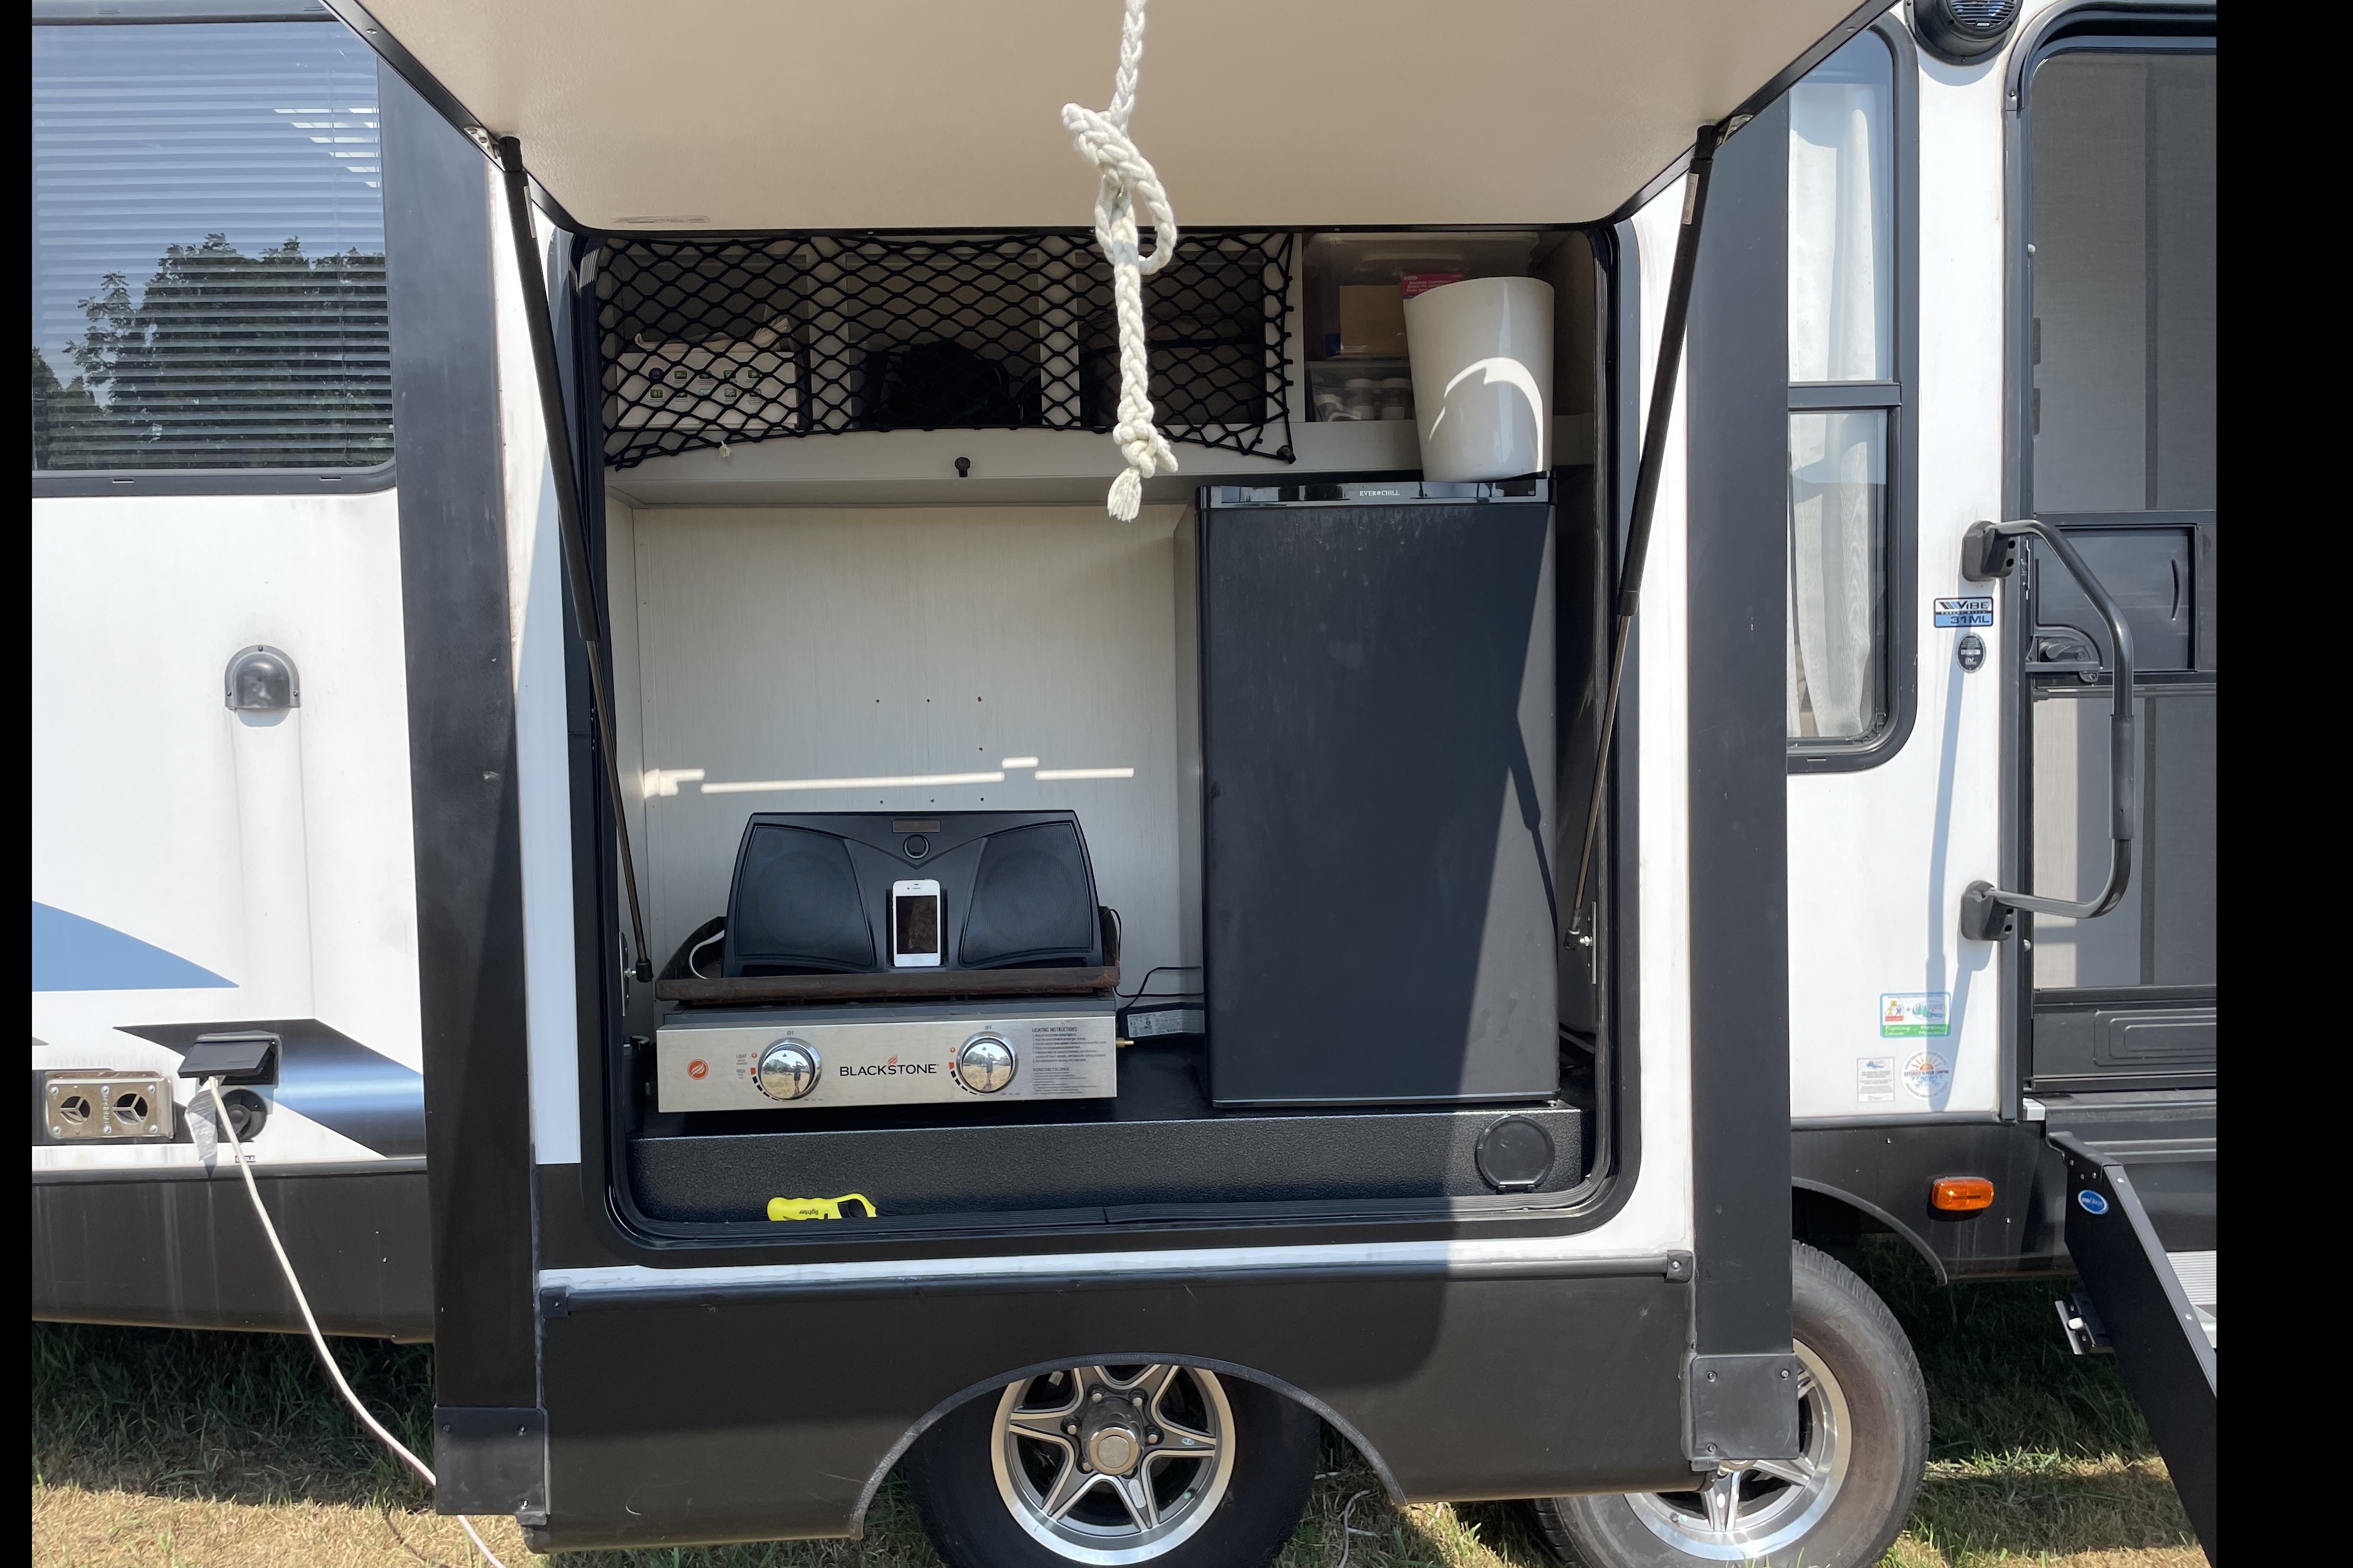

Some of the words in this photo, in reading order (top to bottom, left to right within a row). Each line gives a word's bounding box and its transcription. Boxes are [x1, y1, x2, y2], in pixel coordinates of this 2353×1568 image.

[1956, 601, 1989, 609] VIBE
[1950, 615, 1989, 624] 31ML
[839, 1064, 937, 1076] BLACKSTONE
